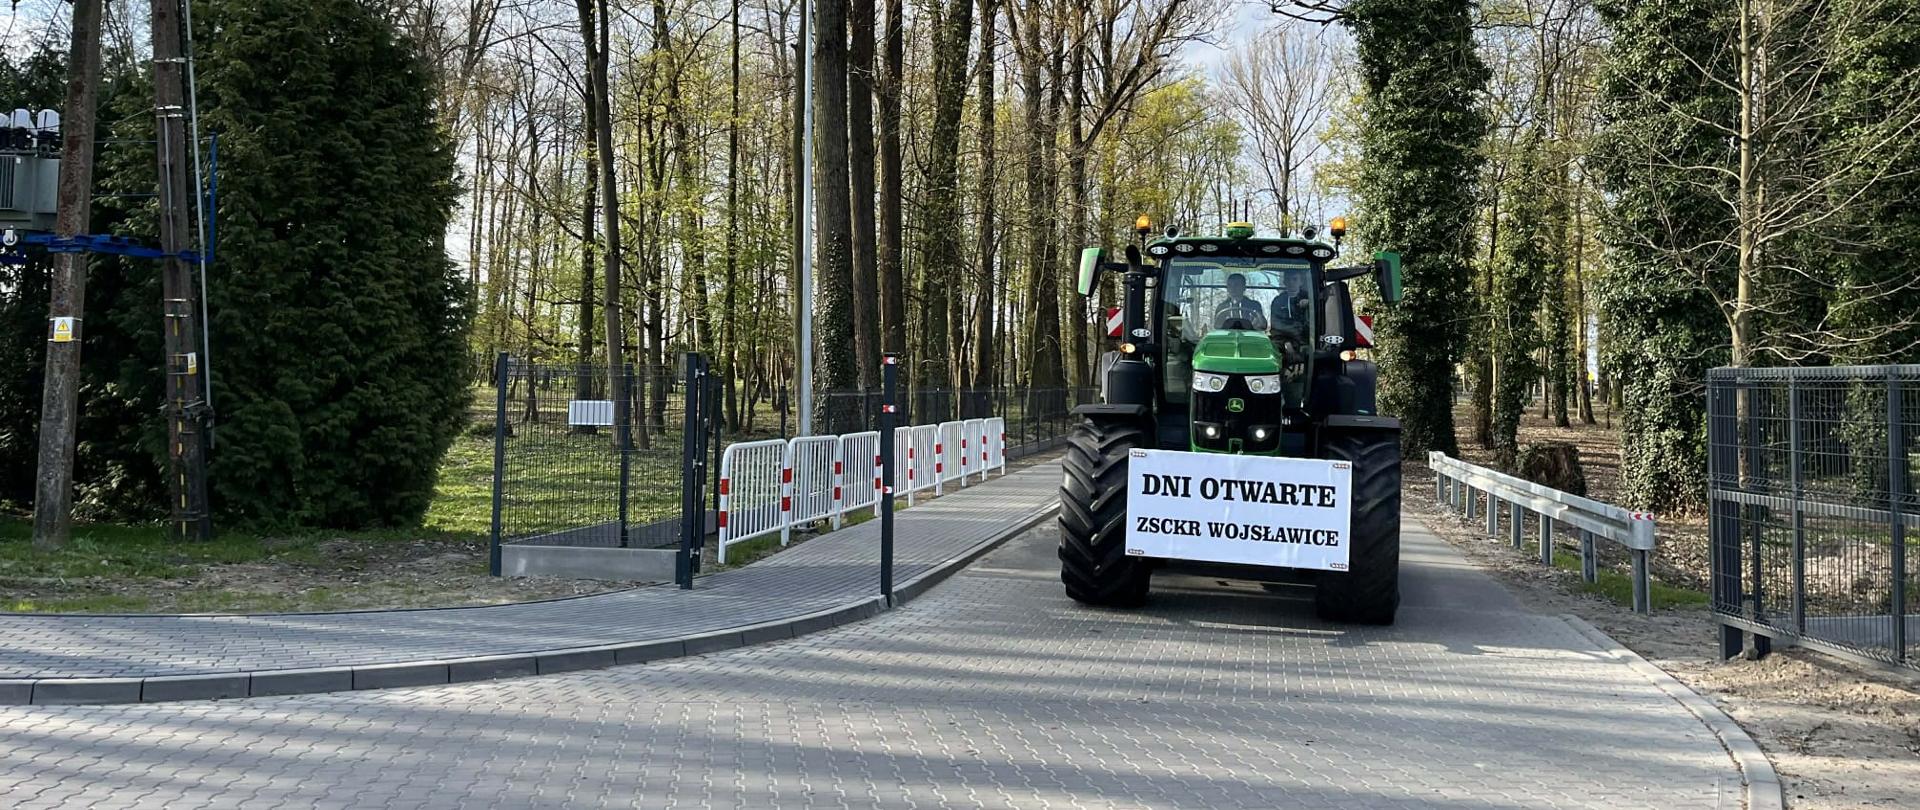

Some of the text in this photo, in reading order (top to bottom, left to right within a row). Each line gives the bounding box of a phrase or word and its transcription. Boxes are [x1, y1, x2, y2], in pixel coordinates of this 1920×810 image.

[1142, 473, 1336, 508] DNI OTWARTE
[1136, 516, 1339, 547] ZSCKR WOJSŁAWICE
